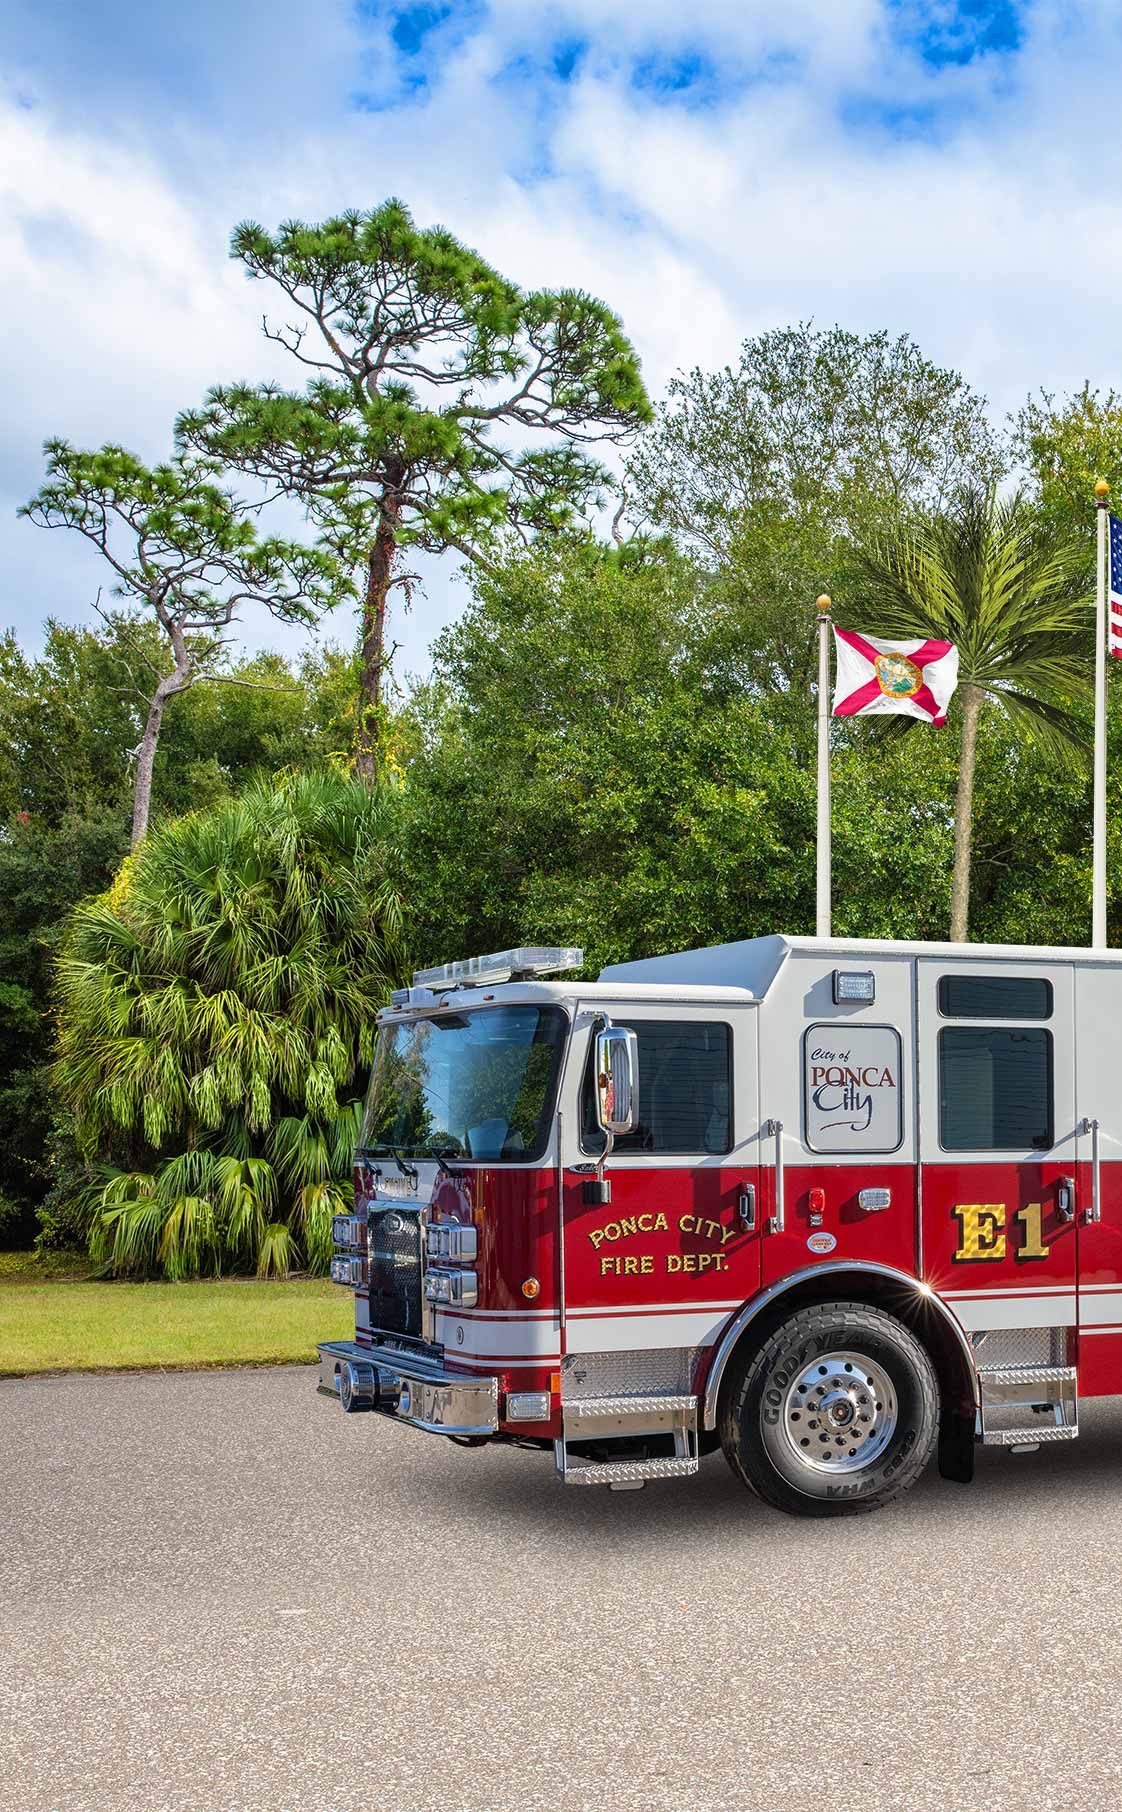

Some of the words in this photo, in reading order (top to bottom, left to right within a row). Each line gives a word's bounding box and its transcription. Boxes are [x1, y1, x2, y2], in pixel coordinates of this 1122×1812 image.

[811, 1048, 836, 1061] City
[839, 1049, 851, 1062] of
[811, 1066, 896, 1087] PONCA
[812, 1079, 873, 1131] City
[587, 1212, 669, 1250] PONCA
[678, 1214, 736, 1245] CITY
[951, 1203, 1050, 1264] E1
[600, 1255, 655, 1276] FIRE
[666, 1253, 729, 1273] DEPT.
